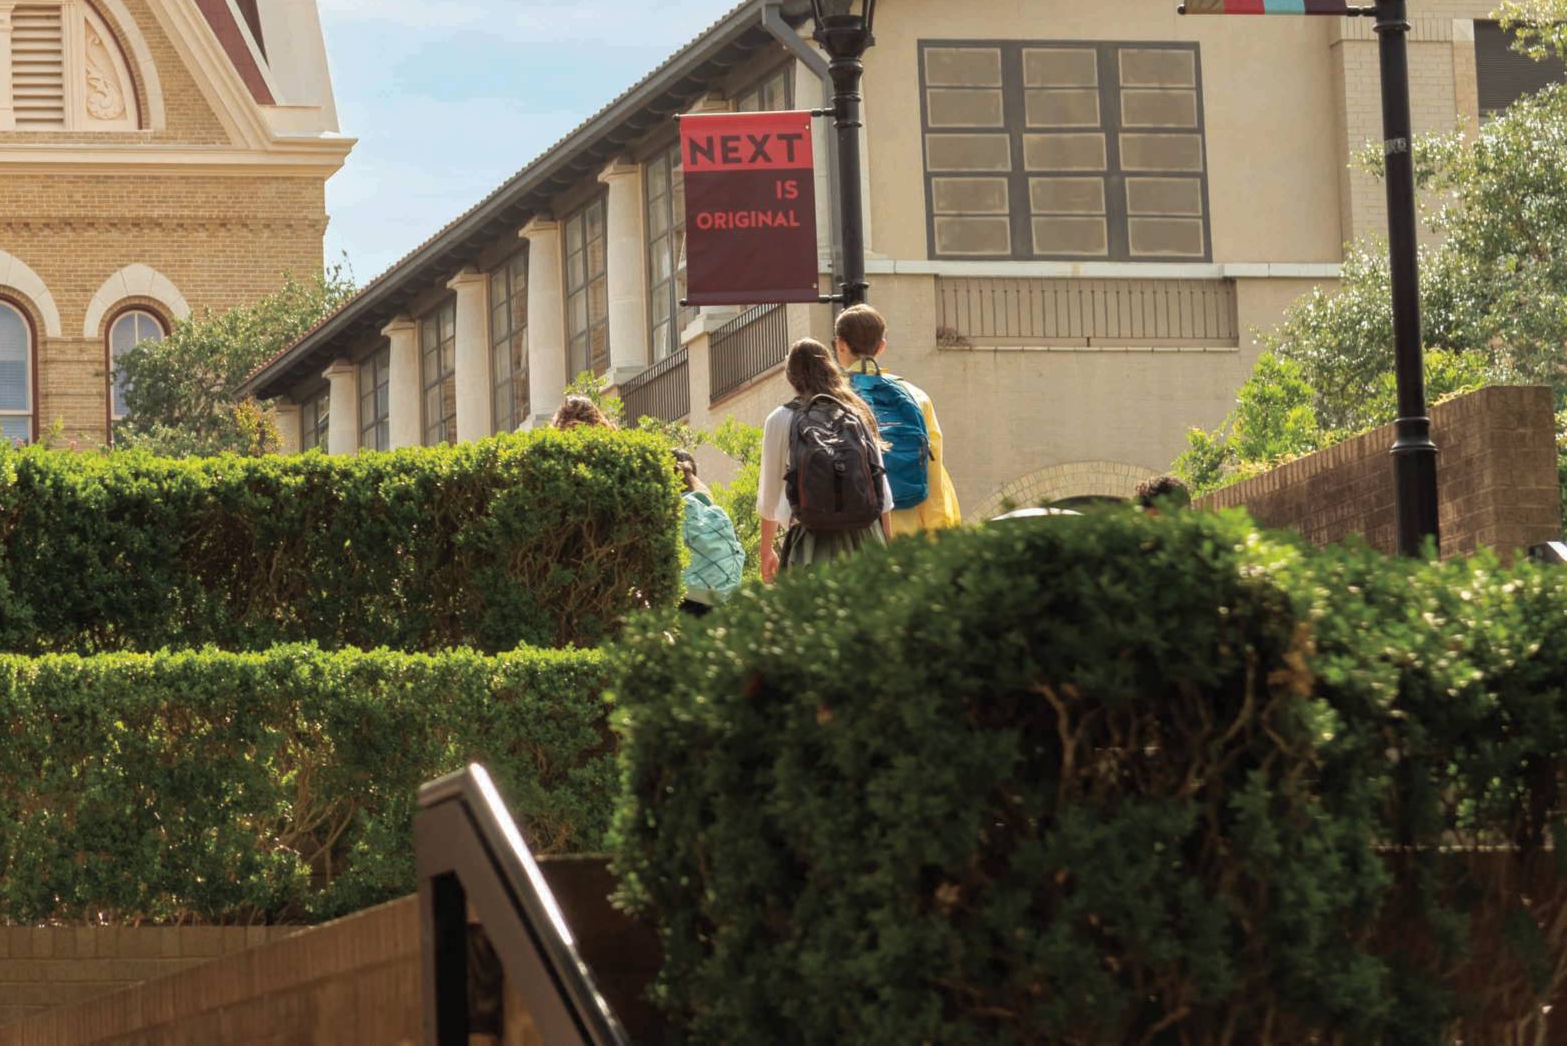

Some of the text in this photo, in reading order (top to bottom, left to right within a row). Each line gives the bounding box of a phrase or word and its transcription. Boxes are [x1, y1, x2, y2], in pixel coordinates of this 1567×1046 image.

[688, 133, 802, 165] NEXT
[776, 180, 799, 199] IS
[697, 210, 800, 229] ORIGINAL
